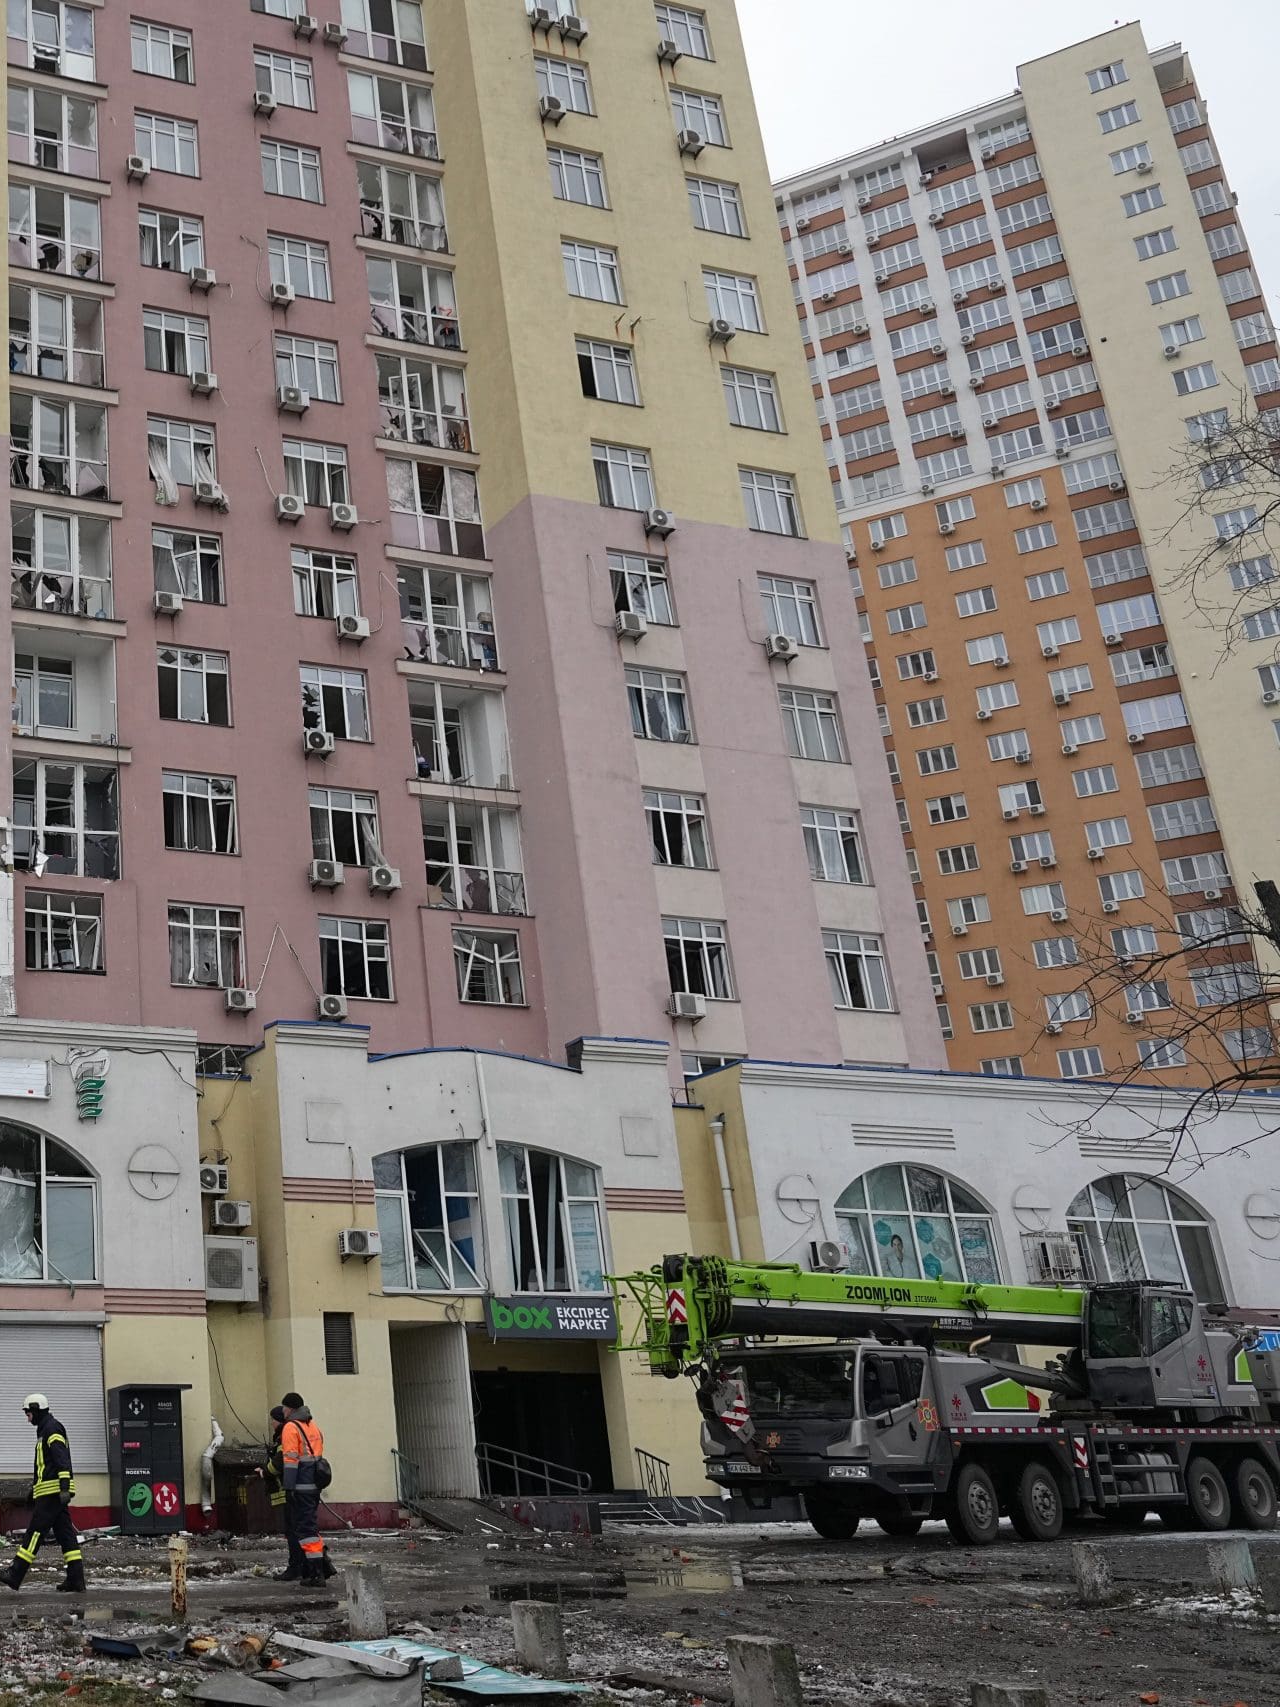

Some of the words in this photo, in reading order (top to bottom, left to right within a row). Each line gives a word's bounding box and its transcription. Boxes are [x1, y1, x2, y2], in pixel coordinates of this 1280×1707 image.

[845, 1285, 911, 1302] ZOOMLION
[490, 1298, 552, 1329] box
[556, 1307, 610, 1319] ЕКСПРЕС
[558, 1319, 607, 1330] МАРКЕТ
